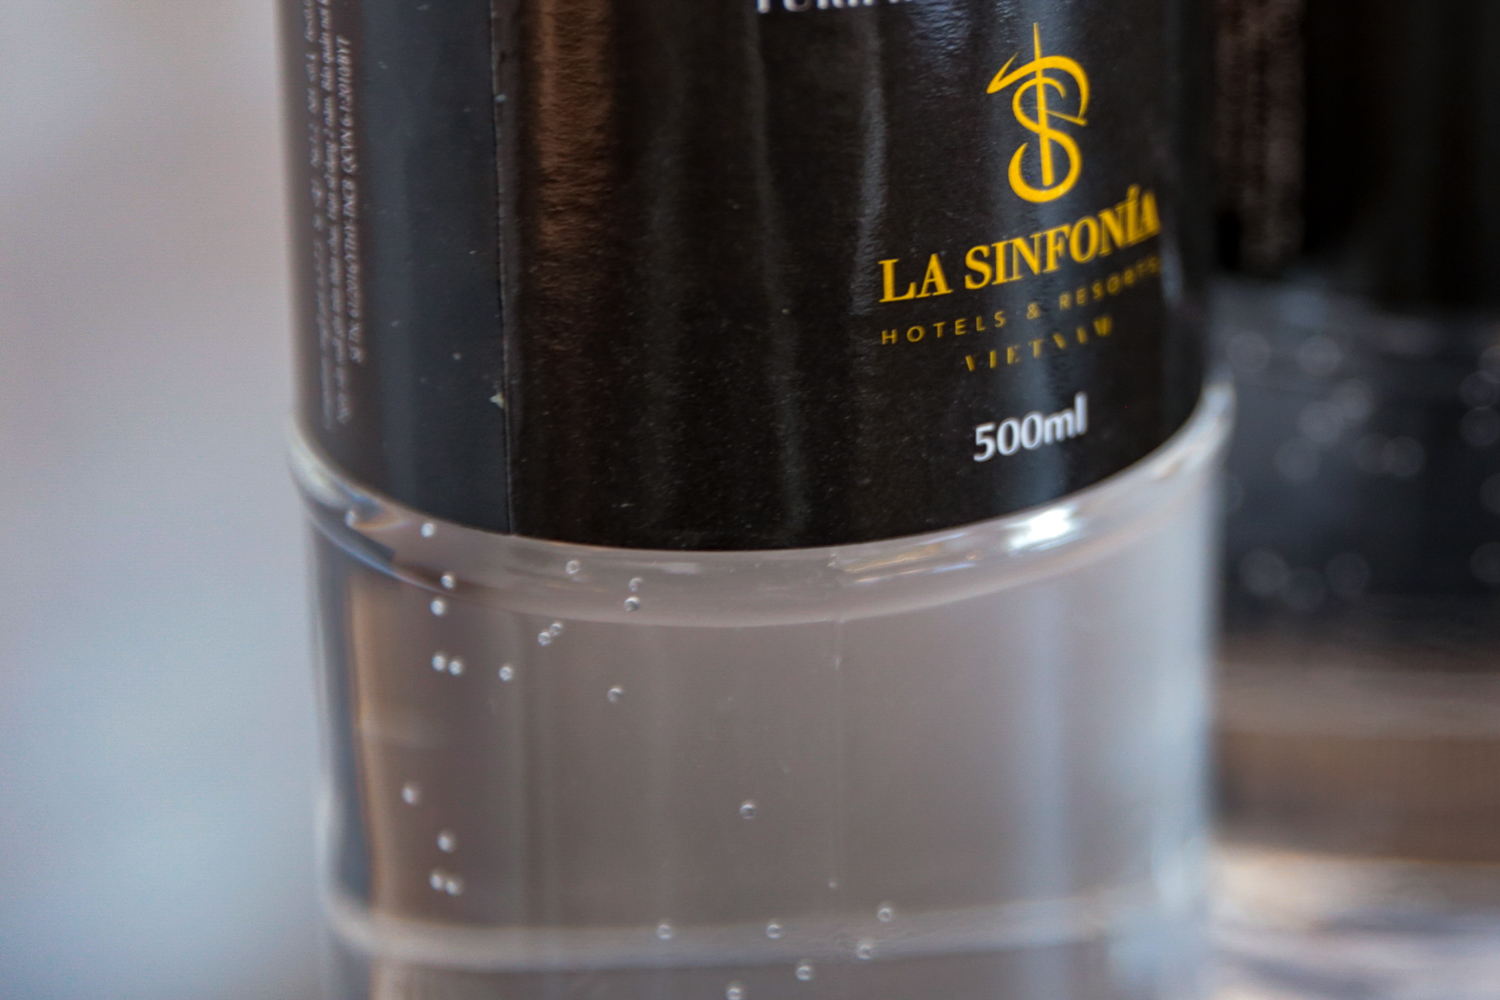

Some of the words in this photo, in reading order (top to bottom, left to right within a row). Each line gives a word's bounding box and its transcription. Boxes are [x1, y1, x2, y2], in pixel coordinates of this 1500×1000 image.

[878, 253, 953, 302] LA
[964, 184, 1161, 290] SINFONÍA
[881, 310, 1005, 345] HOTELS
[1026, 301, 1041, 321] &
[973, 391, 1088, 462] 500ml
